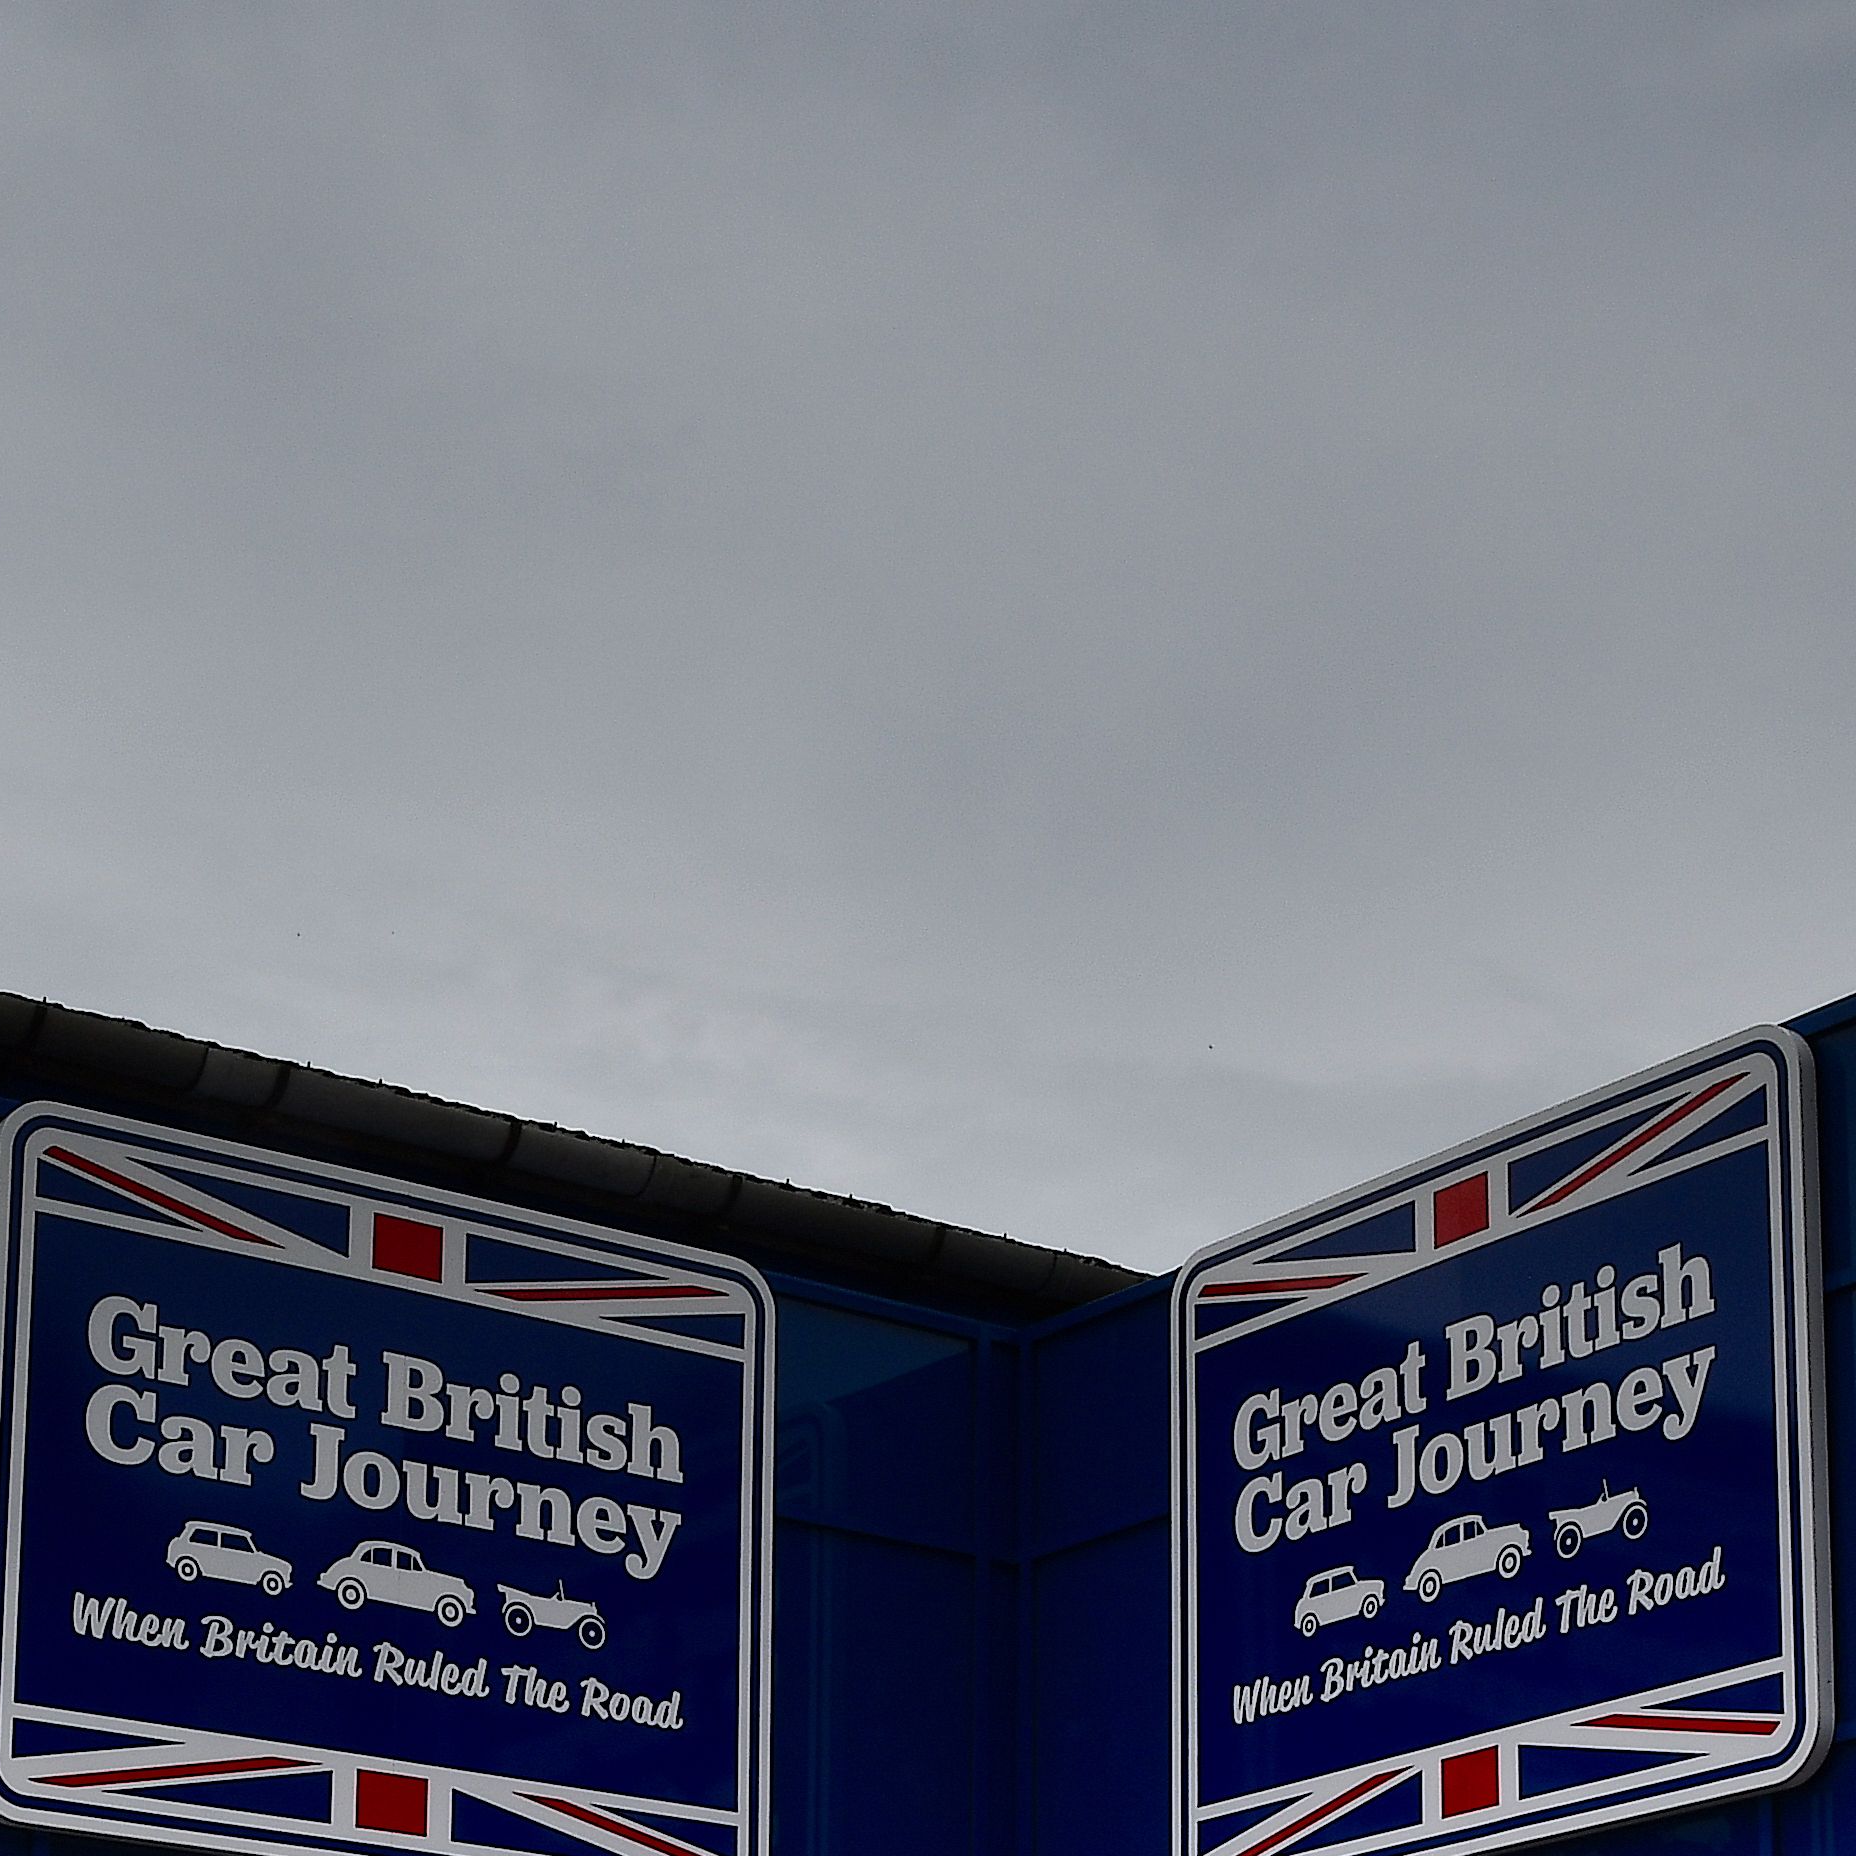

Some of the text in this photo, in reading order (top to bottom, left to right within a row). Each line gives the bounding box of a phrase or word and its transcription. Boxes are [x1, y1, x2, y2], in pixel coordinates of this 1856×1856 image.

[87, 1295, 684, 1484] Great British
[1233, 1242, 1716, 1471] Great British
[1234, 1345, 1716, 1553] Car Journey
[85, 1384, 682, 1580] Car Journey
[72, 1591, 684, 1730] When Britain Ruled The Road
[1233, 1545, 1726, 1725] When Britain Ruled The Road
